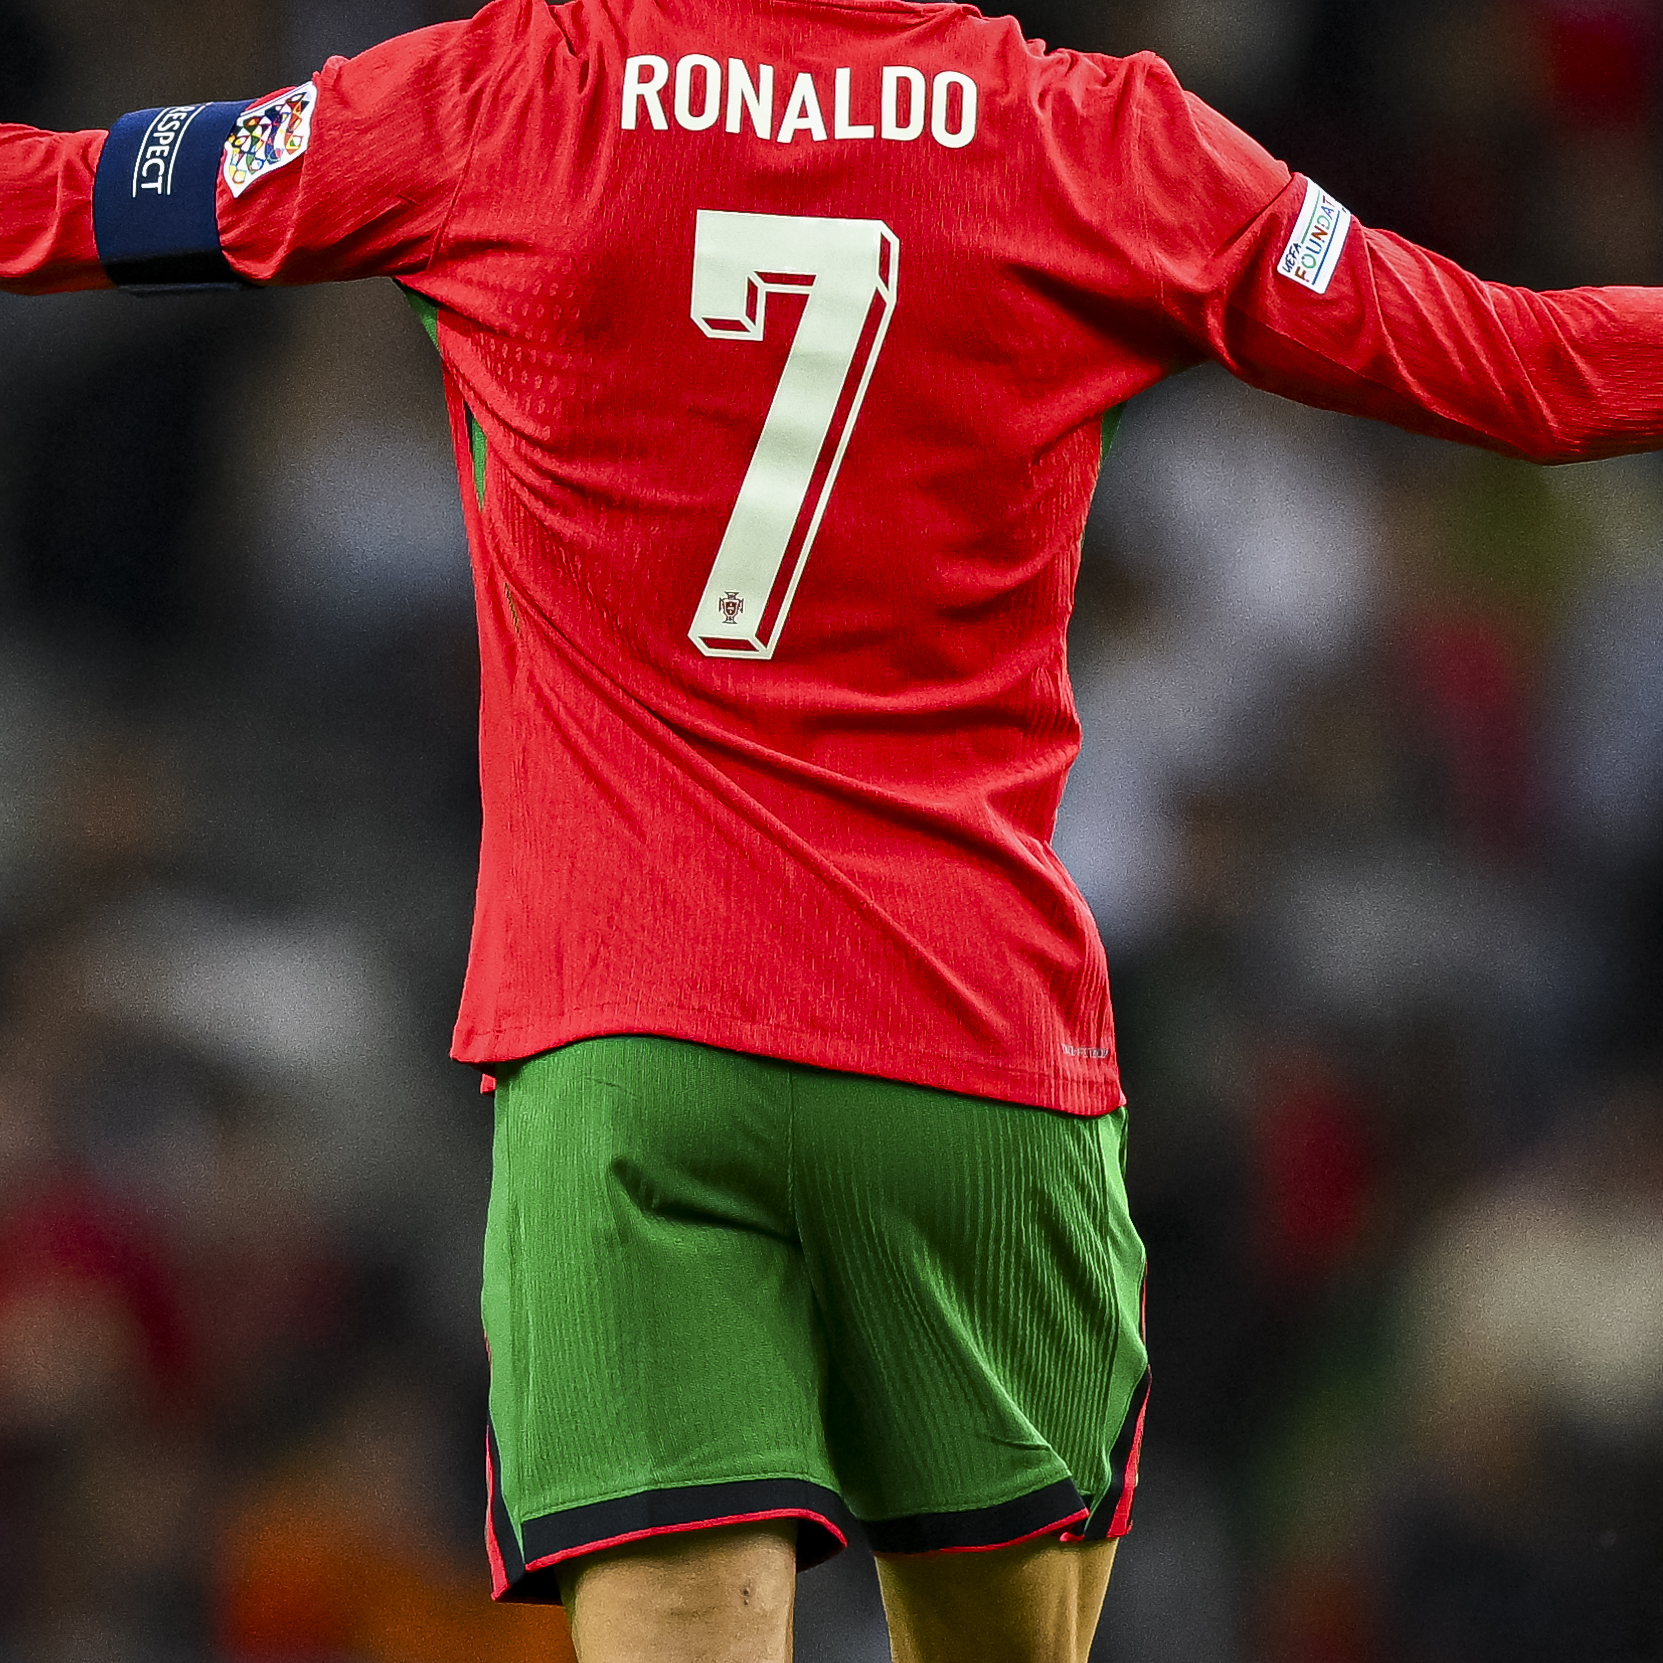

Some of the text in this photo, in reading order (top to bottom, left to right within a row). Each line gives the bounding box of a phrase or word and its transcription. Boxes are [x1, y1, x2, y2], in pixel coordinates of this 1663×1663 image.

[620, 52, 979, 149] RONALDO
[140, 105, 196, 195] RESPECT
[1282, 242, 1302, 273] UEFA
[687, 208, 901, 661] 7
